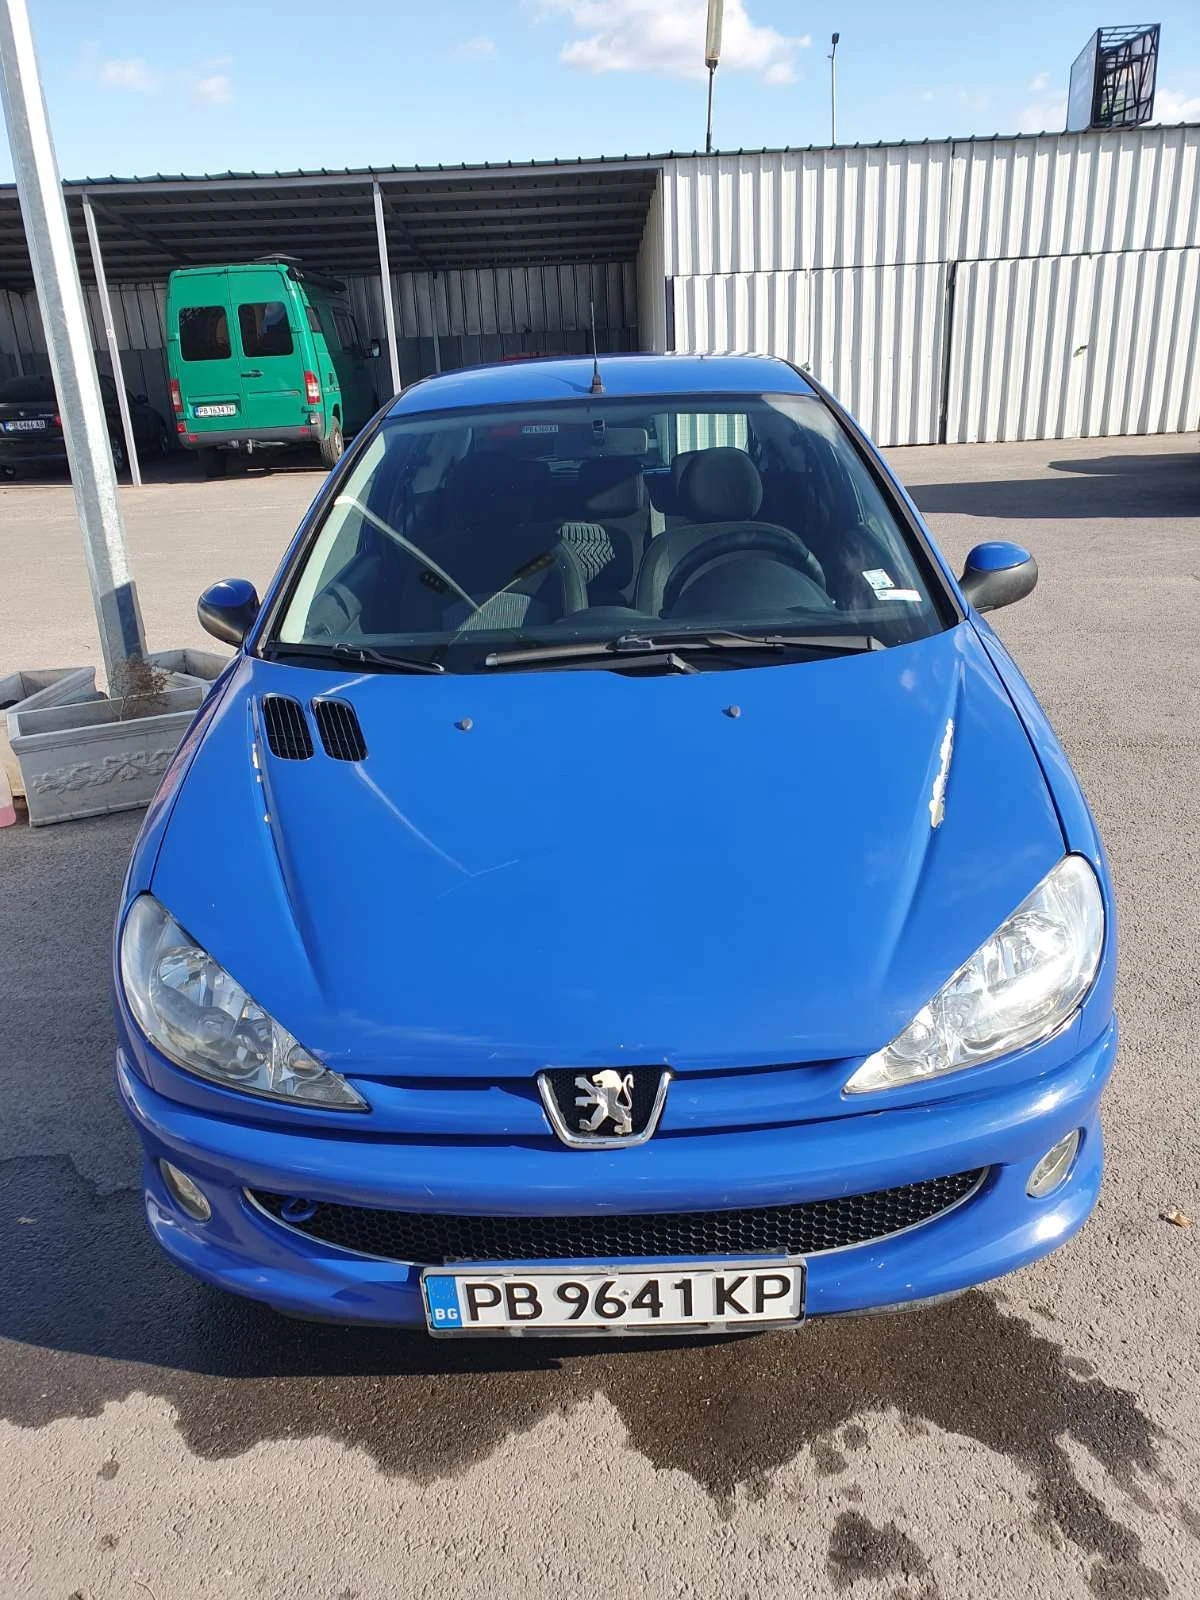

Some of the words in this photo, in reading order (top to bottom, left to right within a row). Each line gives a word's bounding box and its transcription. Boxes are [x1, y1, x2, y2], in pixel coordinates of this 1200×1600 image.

[199, 407, 209, 415] PB
[465, 1282, 543, 1321] PB
[556, 1278, 694, 1320] 9641
[714, 1274, 792, 1316] KP
[434, 1308, 458, 1321] BG
